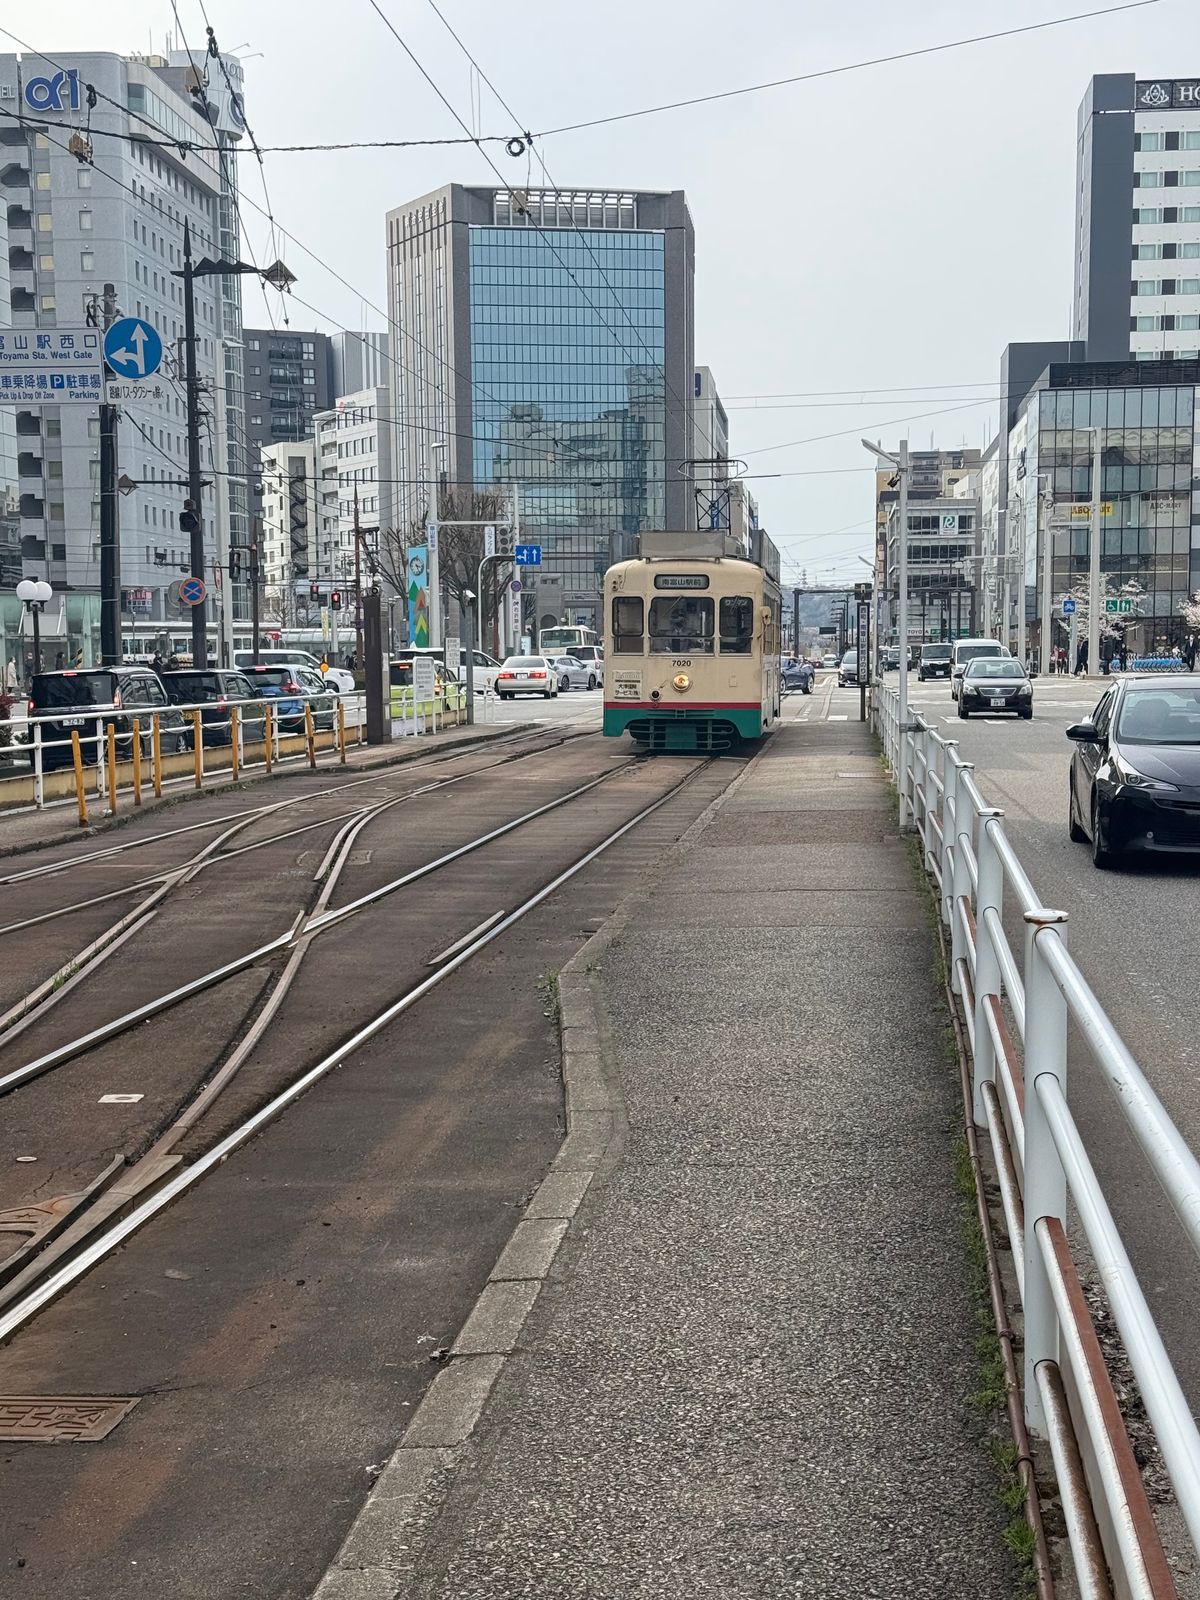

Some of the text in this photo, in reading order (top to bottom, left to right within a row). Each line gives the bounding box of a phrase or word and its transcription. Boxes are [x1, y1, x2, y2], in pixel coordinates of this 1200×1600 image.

[0, 352, 29, 361] Toyama
[50, 351, 70, 359] West
[73, 350, 93, 359] Gate
[0, 374, 48, 390] 車乗降場
[66, 374, 101, 389] 駐車場
[69, 391, 100, 400] Parking
[661, 578, 702, 586] 南富山駅前
